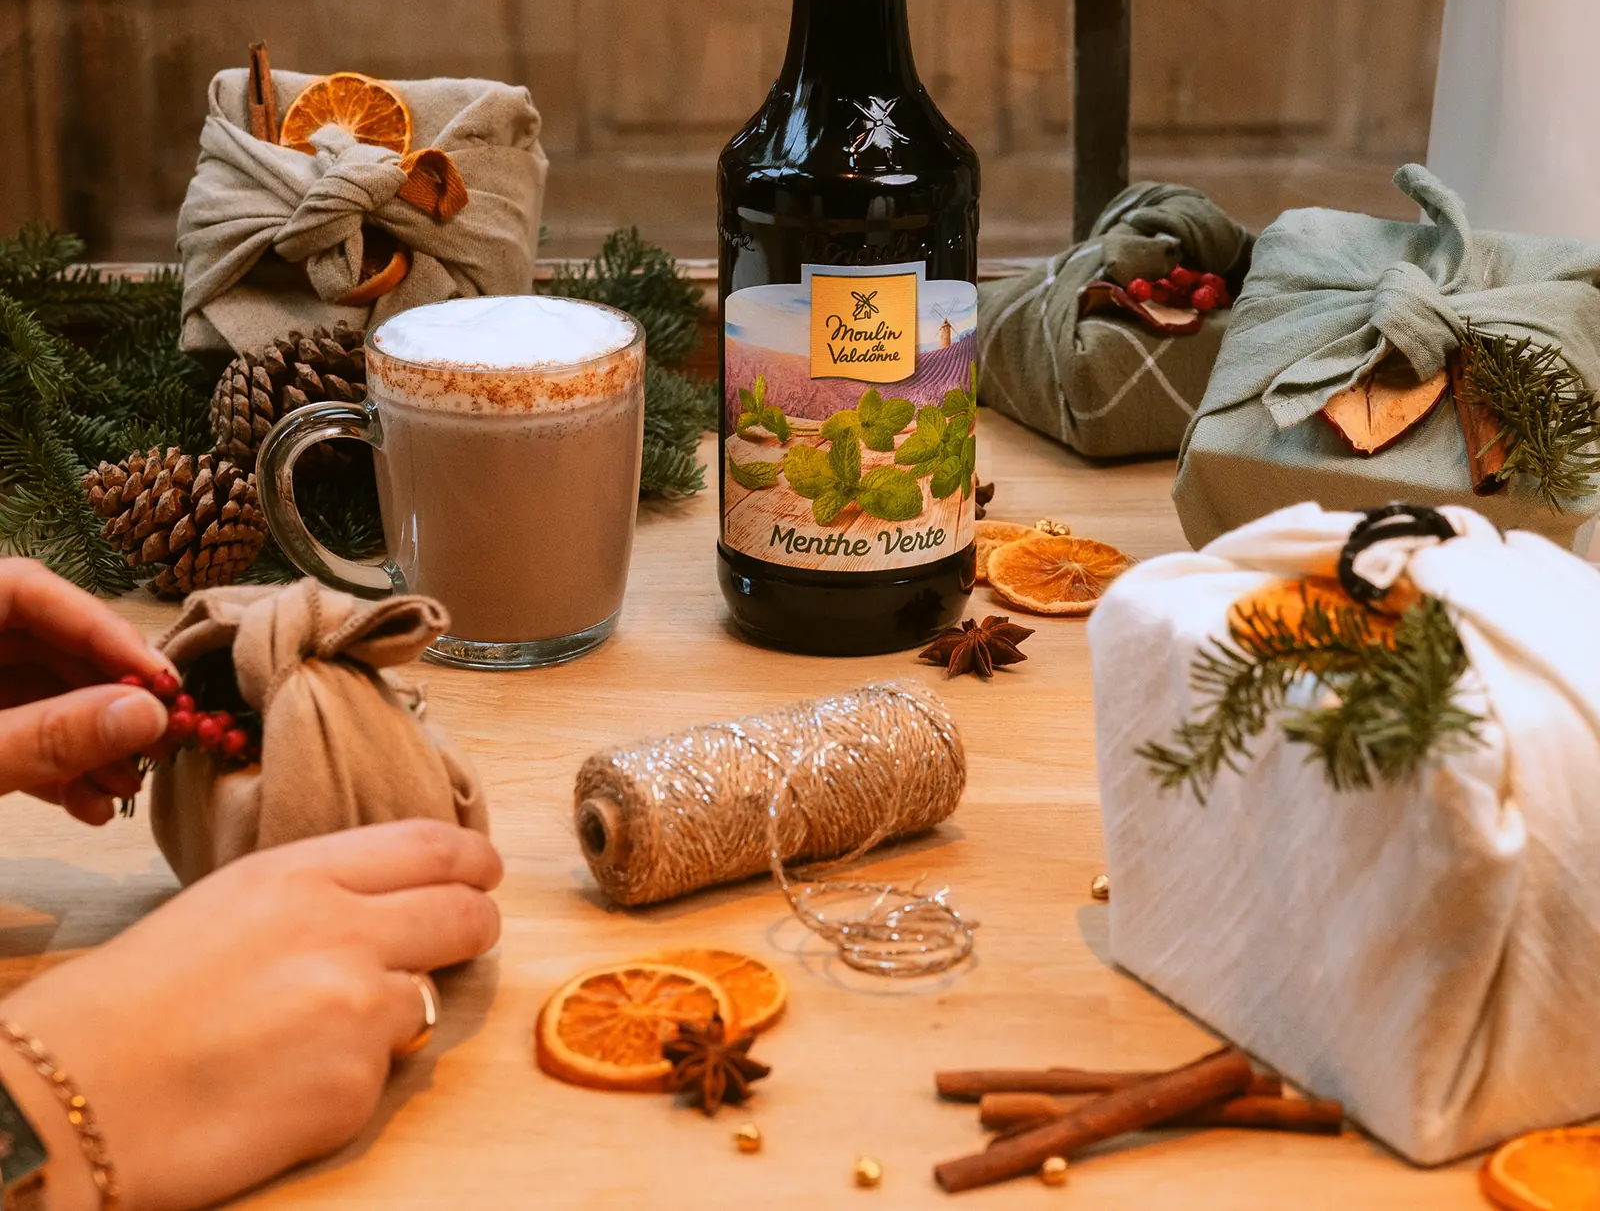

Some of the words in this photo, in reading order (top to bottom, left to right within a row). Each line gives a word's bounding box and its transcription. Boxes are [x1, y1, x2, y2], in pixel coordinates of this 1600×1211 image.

[825, 314, 903, 342] Moulin
[826, 342, 901, 364] Valdonne
[871, 341, 886, 352] de
[769, 524, 872, 557] Menthe
[877, 525, 947, 555] Verte
